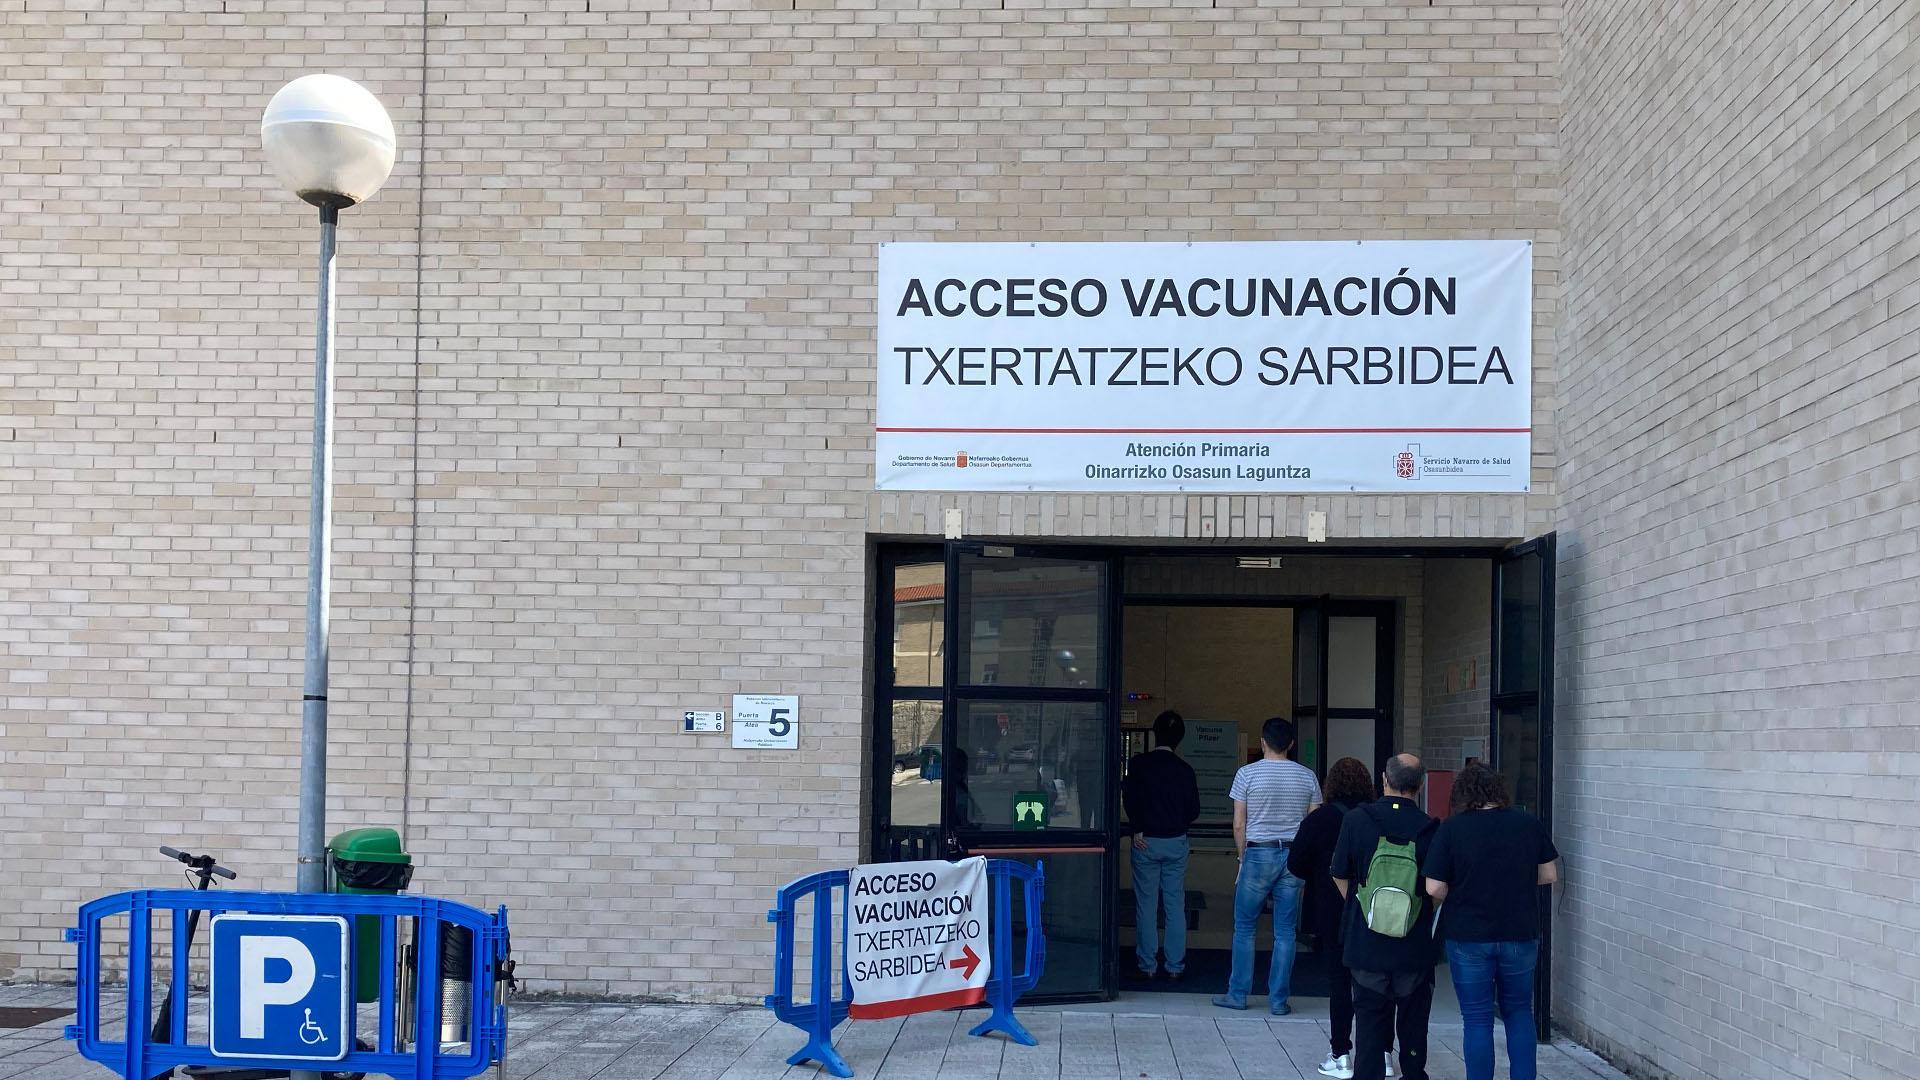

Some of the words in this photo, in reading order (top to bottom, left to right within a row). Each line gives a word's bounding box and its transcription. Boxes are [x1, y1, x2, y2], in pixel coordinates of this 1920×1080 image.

[896, 277, 1109, 318] ACCESO
[1121, 267, 1457, 318] VACUNACIÓN
[893, 346, 1244, 387] TXERTATZEKO
[1257, 346, 1514, 387] SARBIDEA
[1125, 442, 1196, 457] Atención
[1201, 442, 1270, 457] Primaria
[1423, 457, 1451, 465] Servicio
[1452, 457, 1480, 465] Navarro
[1481, 457, 1490, 465] de
[1492, 457, 1511, 465] Salud
[1085, 464, 1167, 479] Oinarrizko
[1172, 464, 1231, 479] Osasun
[1236, 464, 1311, 482] Laguntza
[1423, 465, 1464, 473] Osasunbidea
[715, 712, 722, 721] B
[715, 722, 722, 730] 6
[768, 708, 791, 737] 5
[854, 872, 937, 897] ACCESO
[854, 891, 973, 925] VACUNACIÓN
[854, 919, 981, 953] TXERTATZEKO
[854, 952, 946, 982] SARBIDEA
[239, 935, 316, 1039] P
